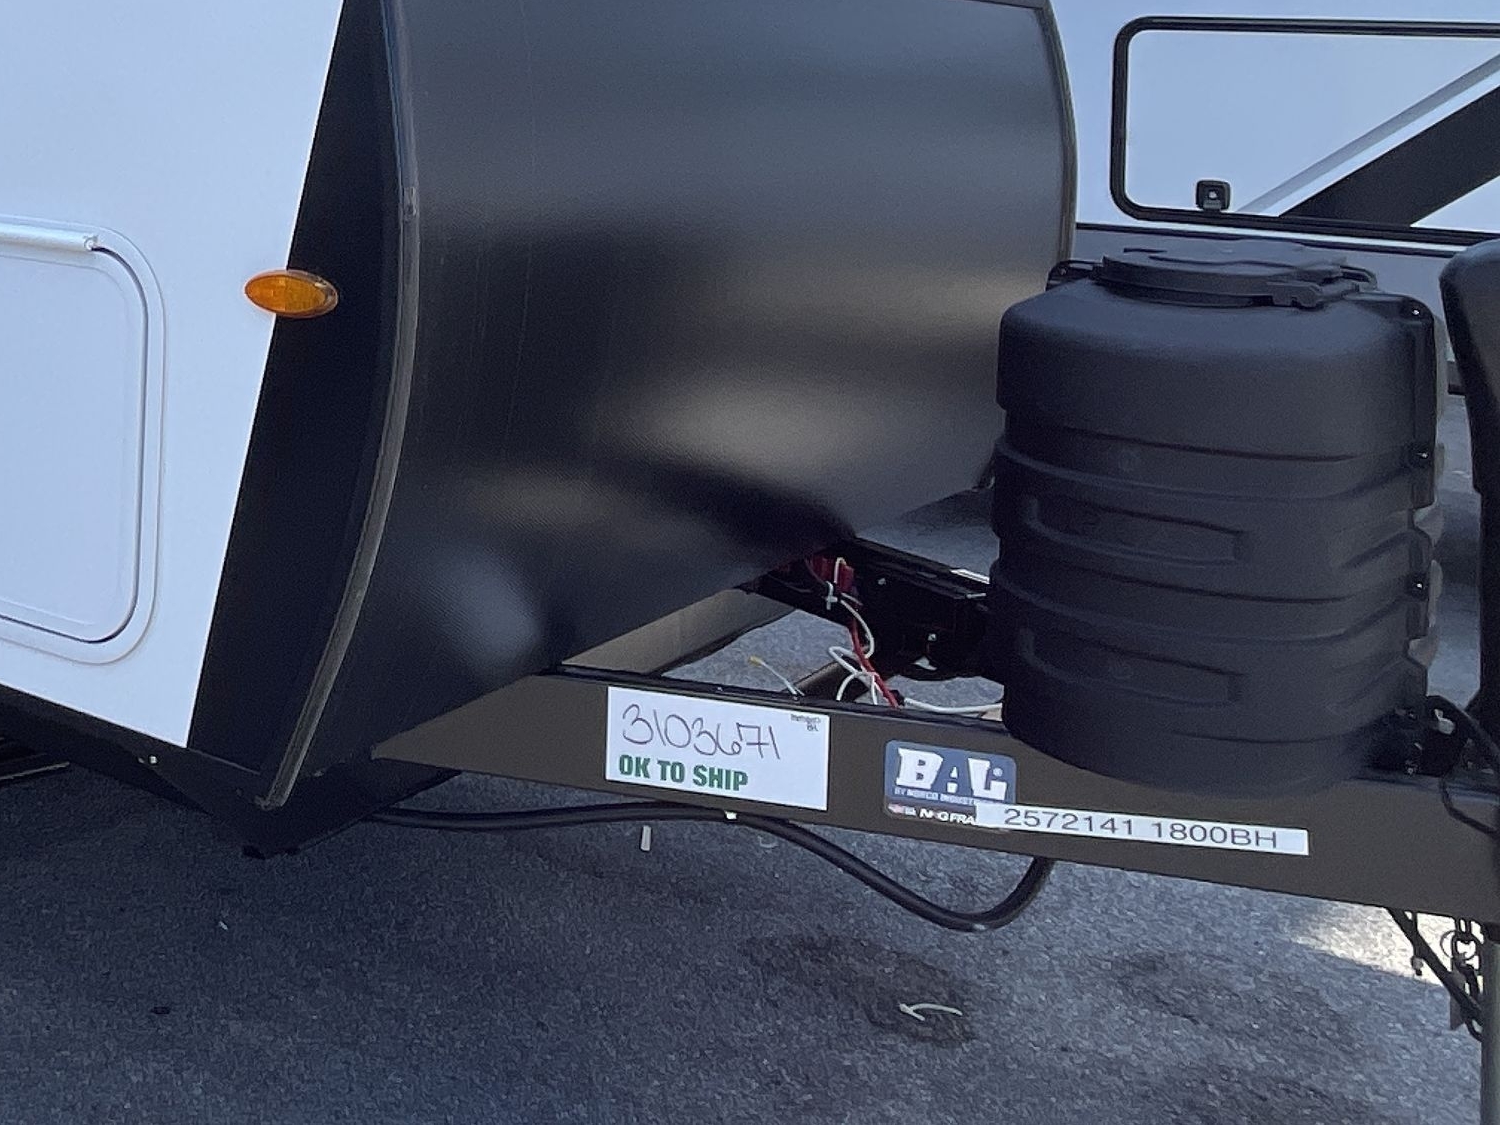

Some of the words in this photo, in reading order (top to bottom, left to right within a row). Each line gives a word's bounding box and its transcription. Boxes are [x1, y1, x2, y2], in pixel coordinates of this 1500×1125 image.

[622, 703, 781, 760] 3103671
[618, 754, 651, 778] OK
[656, 759, 686, 784] TO
[692, 764, 749, 792] SHIP
[1003, 807, 1134, 836] 2572141
[1151, 821, 1278, 849] 1800BH
